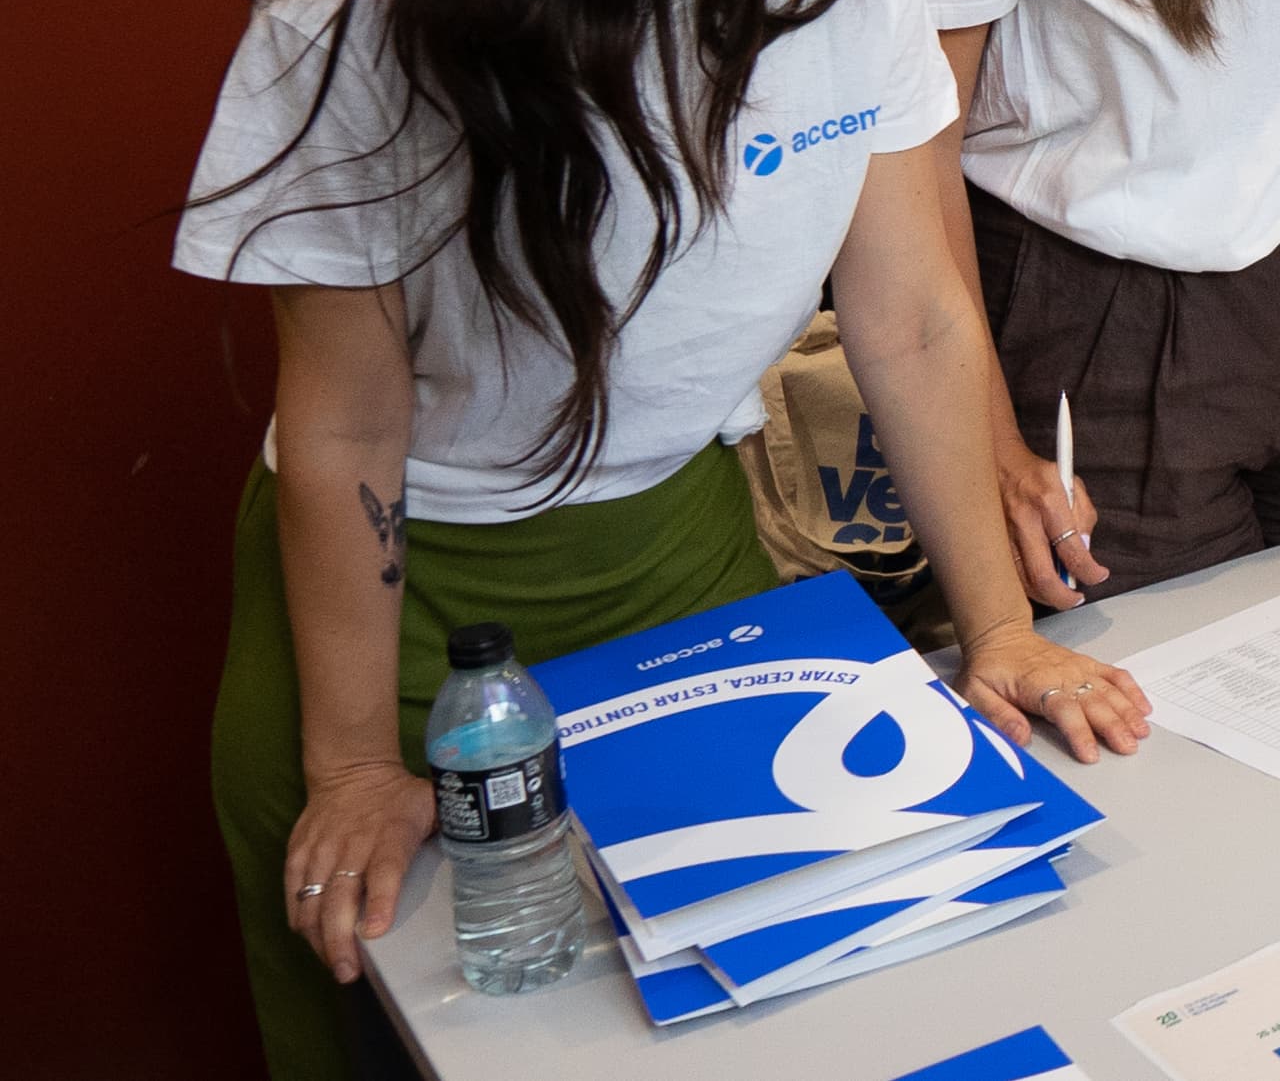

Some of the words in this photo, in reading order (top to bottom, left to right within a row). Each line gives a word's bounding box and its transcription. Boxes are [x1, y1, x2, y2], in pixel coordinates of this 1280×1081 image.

[636, 638, 724, 671] accem
[723, 671, 794, 689] CERCA,
[799, 670, 860, 685] ESTAR
[654, 683, 718, 707] ESTAR
[559, 701, 649, 738] CONTIGO
